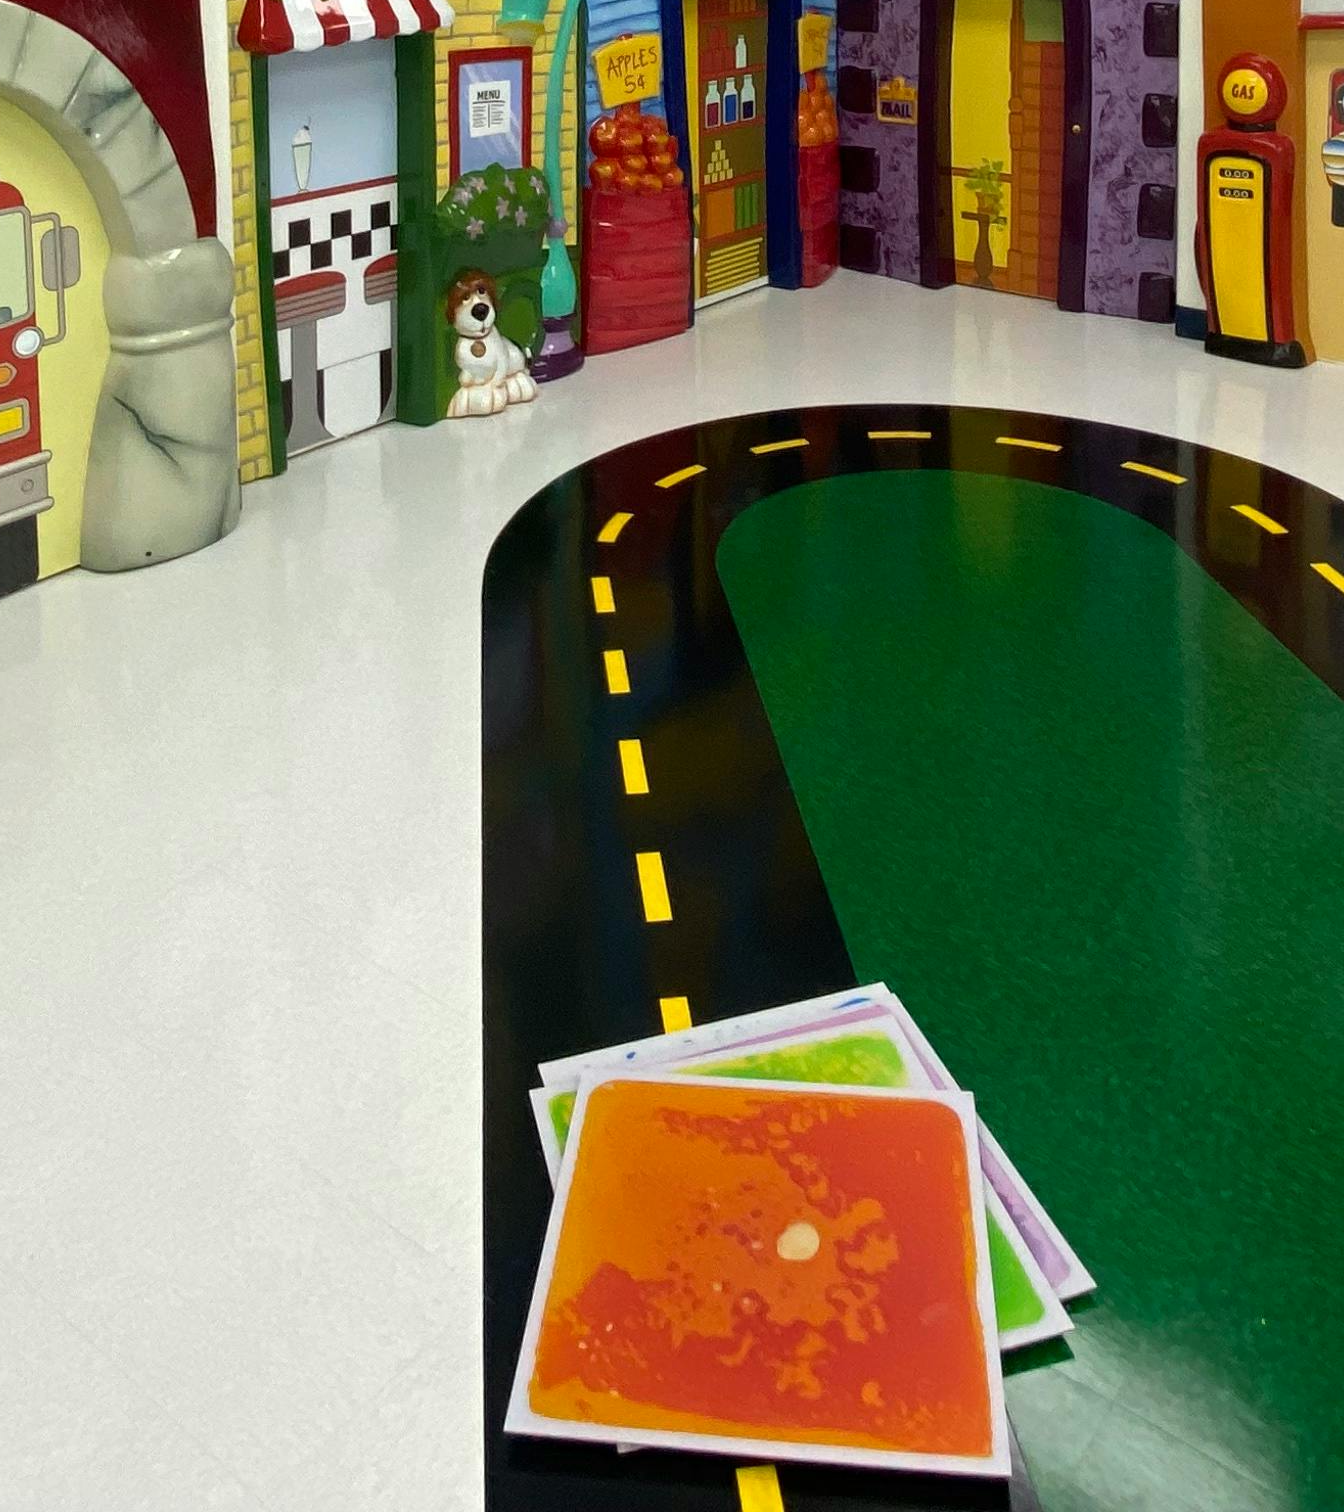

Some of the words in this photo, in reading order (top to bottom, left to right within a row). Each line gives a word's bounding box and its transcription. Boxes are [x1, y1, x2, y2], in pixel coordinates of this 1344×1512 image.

[607, 46, 658, 80] APPLES
[477, 90, 501, 100] MENU
[1231, 84, 1255, 100] GAS
[880, 101, 912, 118] MAIL
